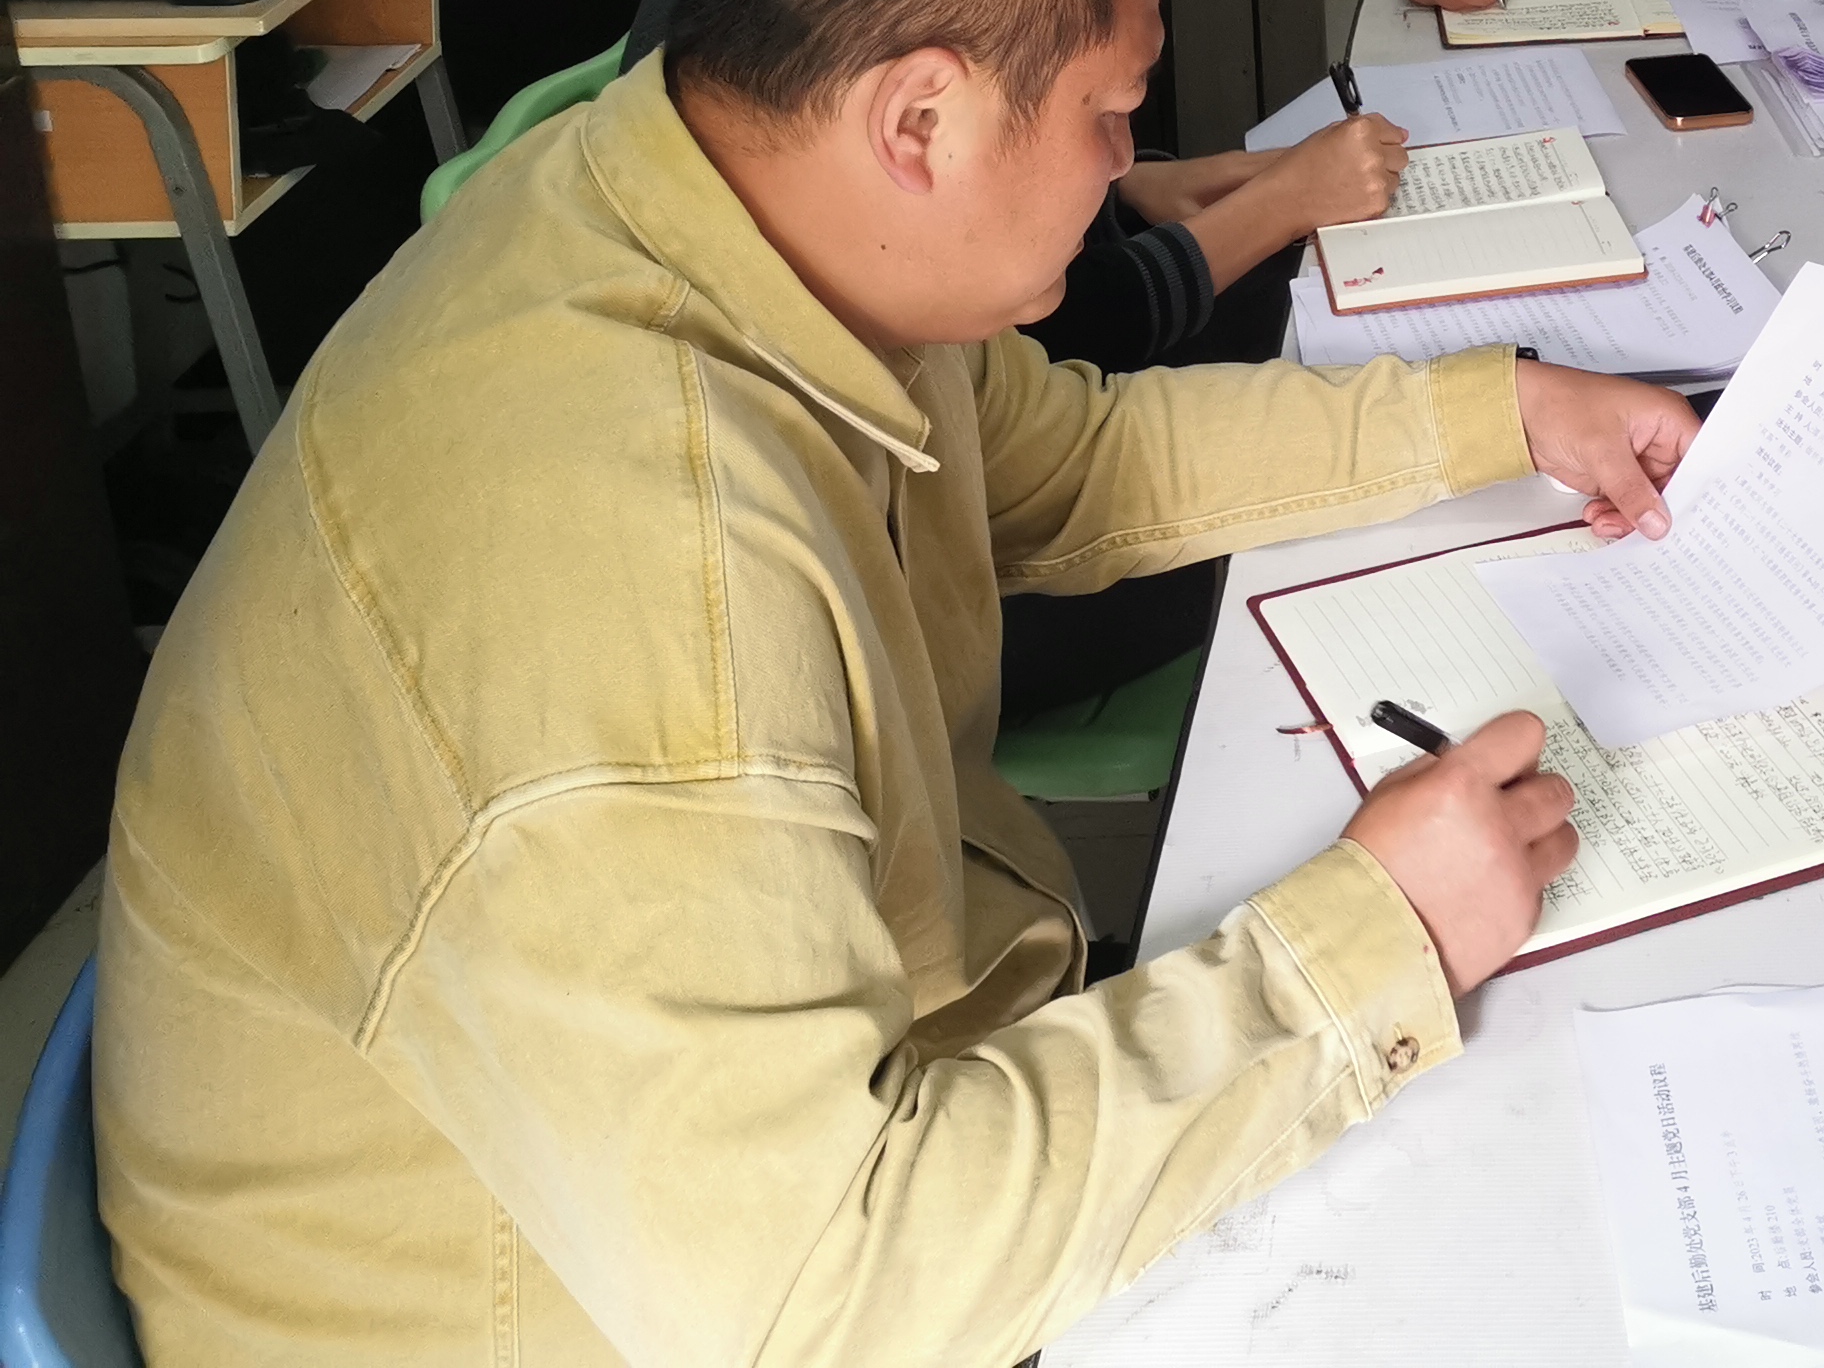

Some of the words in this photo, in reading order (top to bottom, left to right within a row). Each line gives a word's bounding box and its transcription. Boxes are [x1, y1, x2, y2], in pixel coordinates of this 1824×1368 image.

[1647, 1062, 1721, 1314] 基建后勤处党支部4月主题党日活动议程
